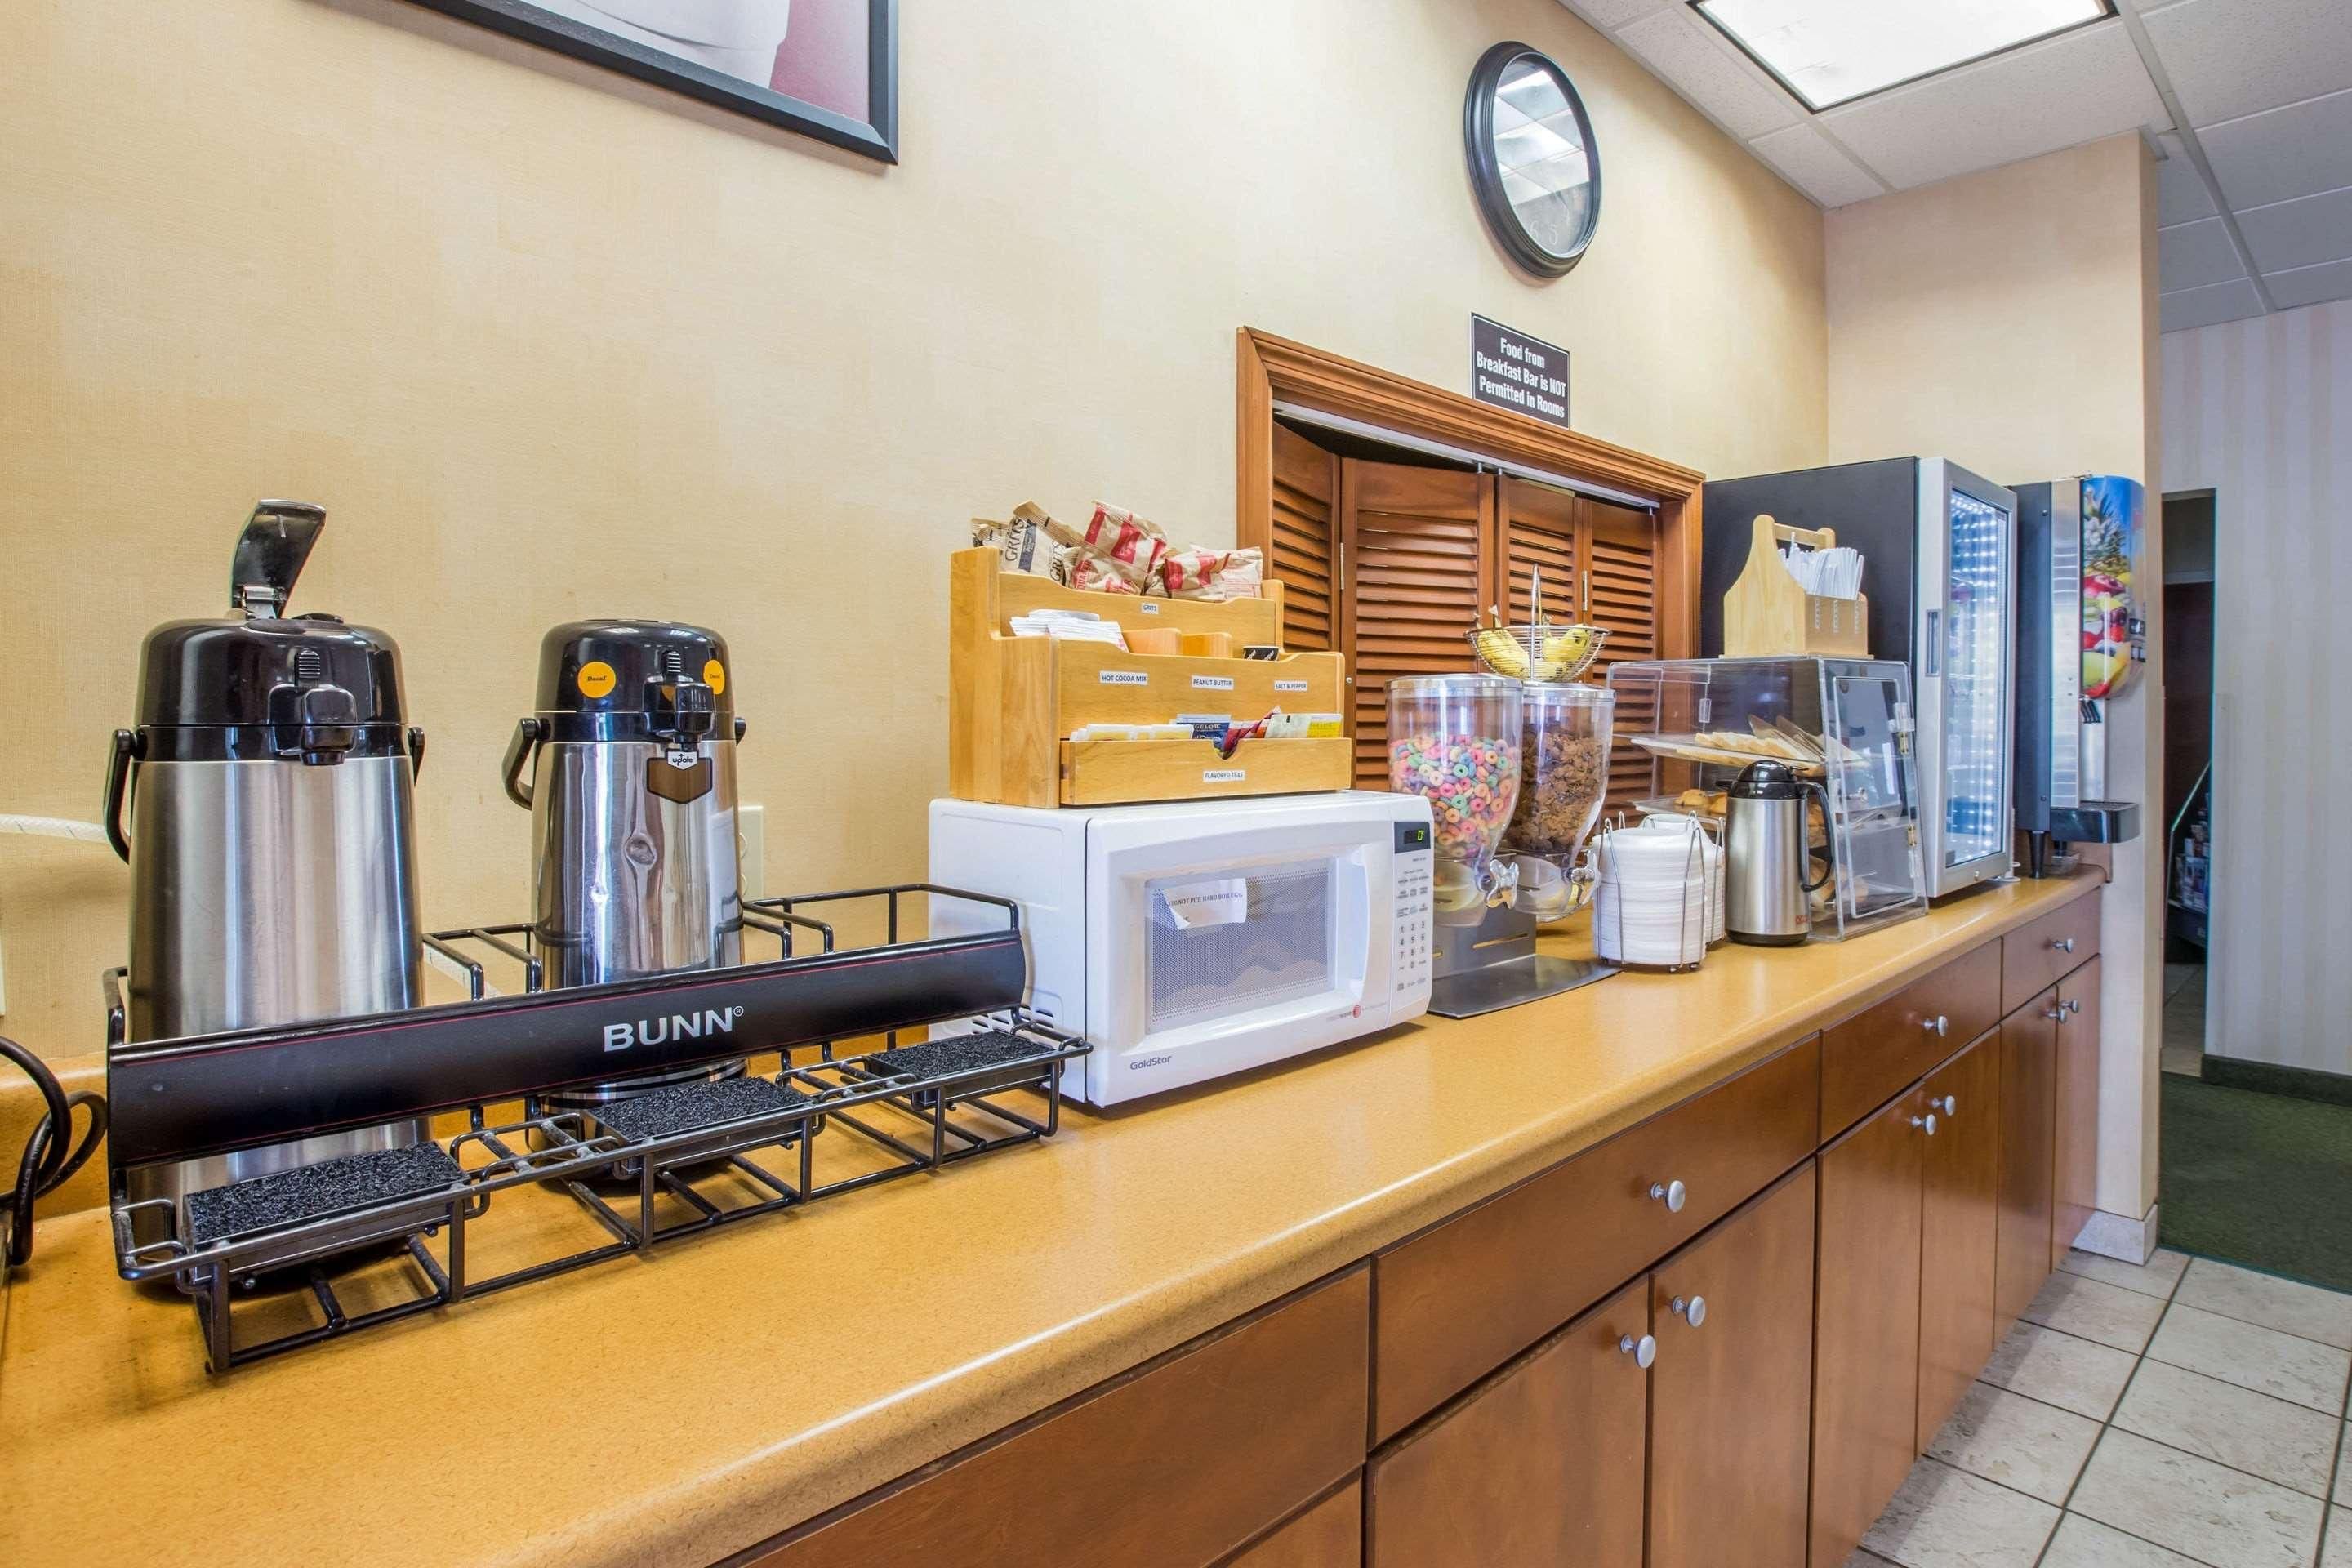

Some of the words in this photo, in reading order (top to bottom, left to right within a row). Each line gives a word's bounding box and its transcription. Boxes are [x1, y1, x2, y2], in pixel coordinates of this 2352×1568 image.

[1500, 337, 1523, 360] Food
[1525, 347, 1545, 368] from
[1476, 350, 1522, 382] Breakfast
[1523, 368, 1539, 388] Bar
[1539, 374, 1548, 392] is
[1549, 377, 1566, 398] NOT
[1479, 375, 1525, 405] Permitted
[1526, 391, 1535, 408] in
[1536, 394, 1566, 418] Rooms
[1205, 771, 1230, 779] FLAVORED
[1417, 830, 1423, 841] 0
[603, 1006, 733, 1053] BUNN
[1129, 1055, 1173, 1071] GoldStar
